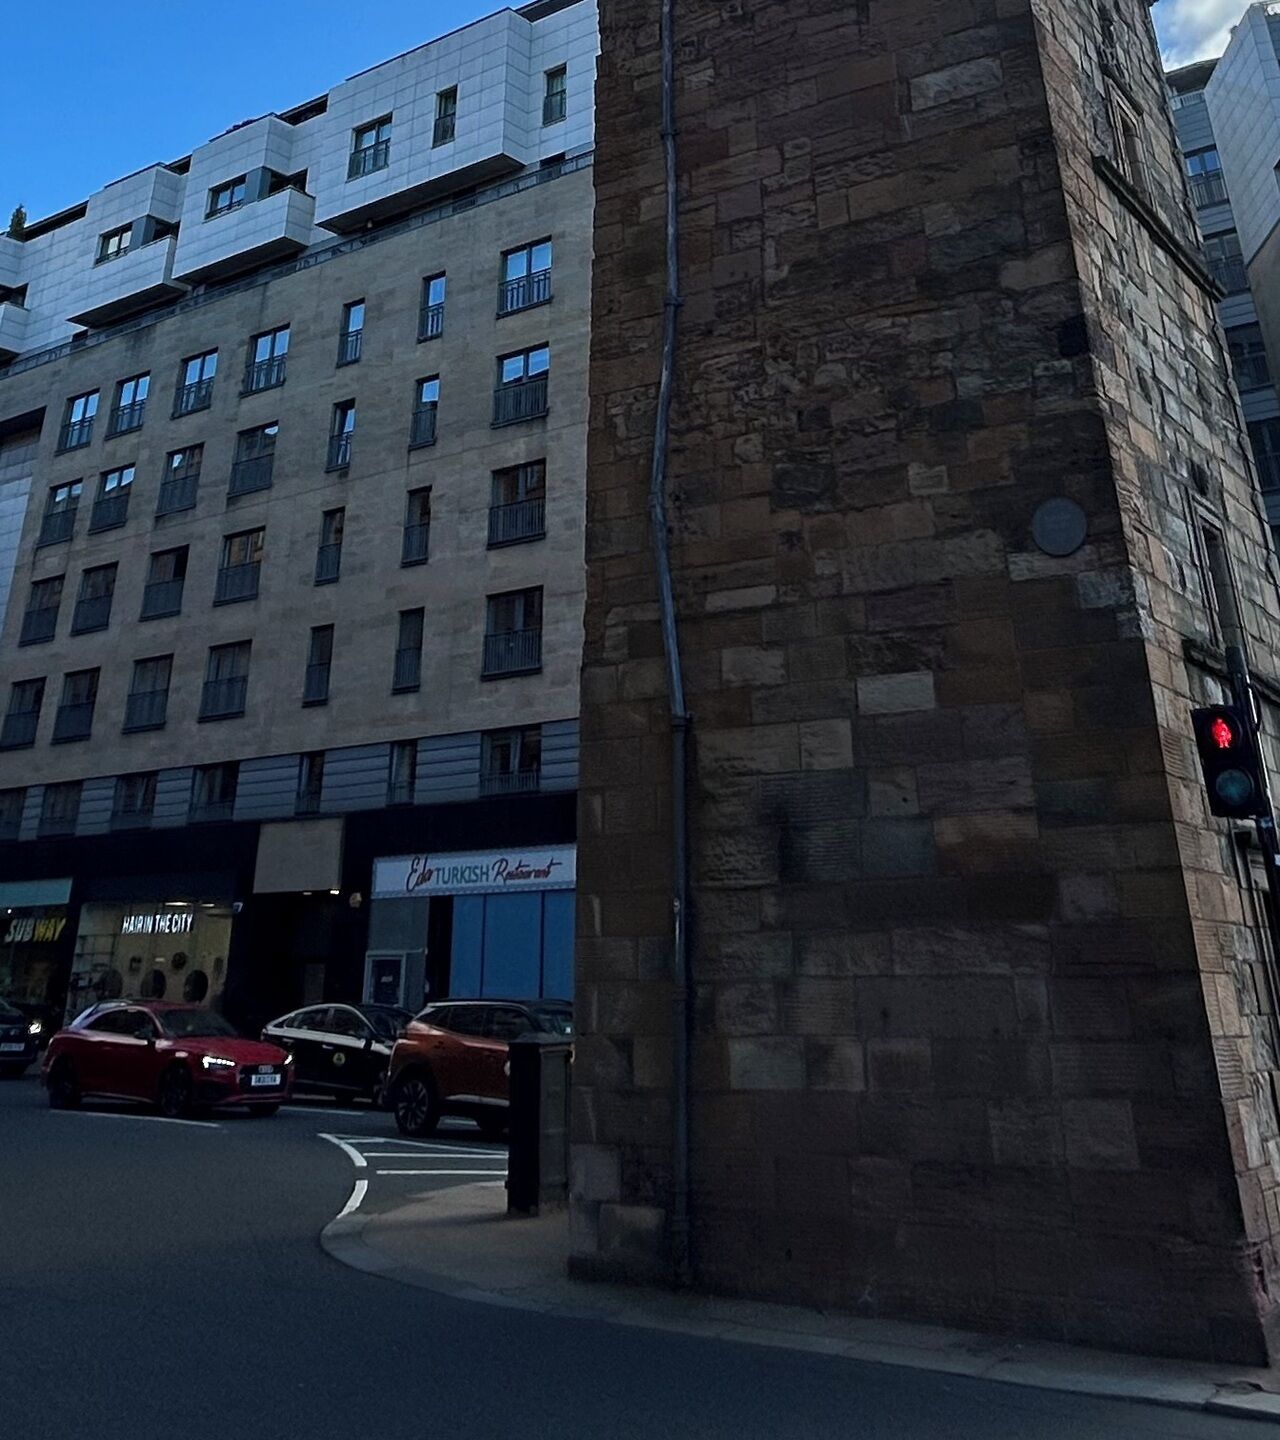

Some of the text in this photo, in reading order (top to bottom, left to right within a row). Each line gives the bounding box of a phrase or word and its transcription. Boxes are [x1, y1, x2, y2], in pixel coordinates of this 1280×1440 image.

[434, 865, 490, 885] TURKISH
[4, 917, 66, 942] SUBWAY
[121, 913, 195, 934] HAIR IN THE CITY
